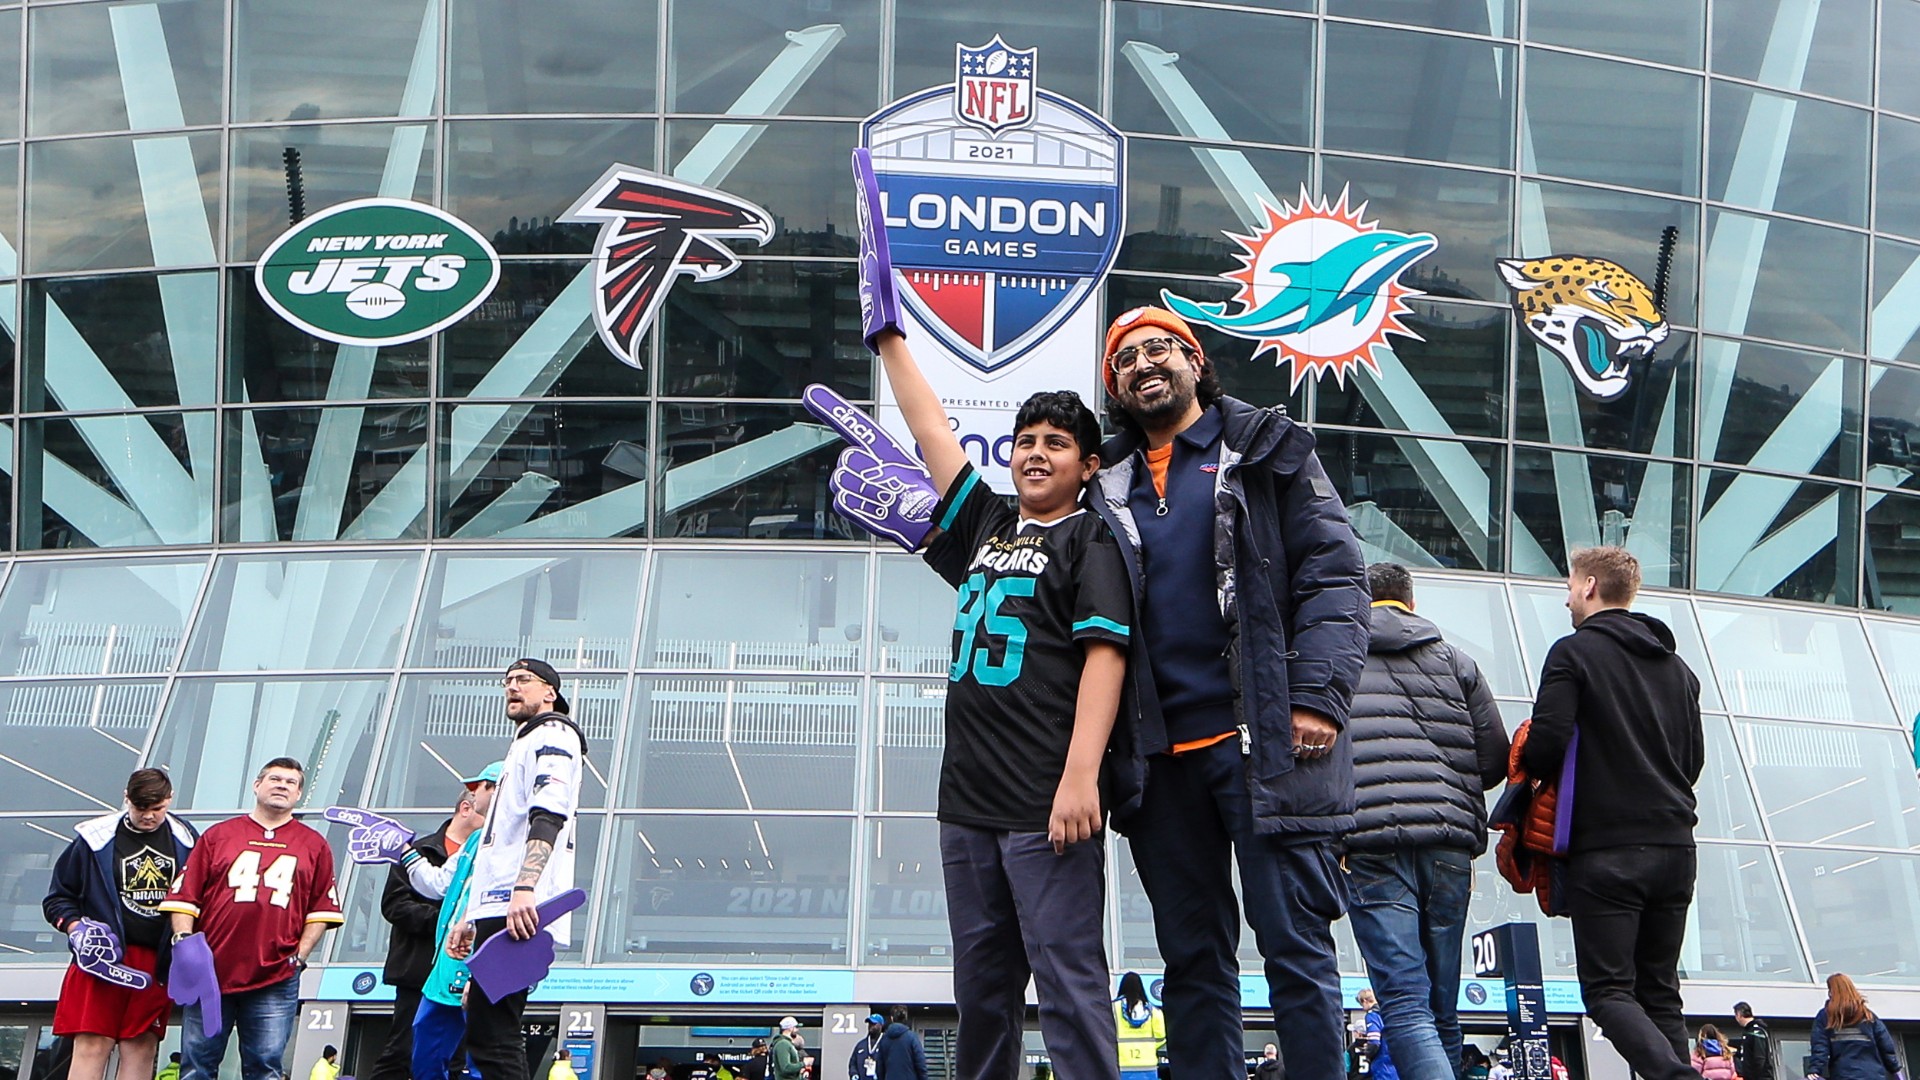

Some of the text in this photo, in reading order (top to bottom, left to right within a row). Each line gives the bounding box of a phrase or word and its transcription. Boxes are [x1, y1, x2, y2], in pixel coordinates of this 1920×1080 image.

[965, 80, 1026, 123] NFL
[969, 145, 1014, 160] 2021
[879, 191, 1106, 237] LONDON
[306, 233, 449, 252] NEW YORK
[944, 239, 1038, 259] GAMES
[287, 254, 467, 296] JETS
[942, 398, 1009, 408] PRESENTED
[832, 406, 876, 444] cinch
[338, 810, 363, 824] cinch
[227, 850, 298, 910] 44
[726, 886, 813, 913] 2021
[819, 888, 882, 915] NL
[1473, 933, 1496, 974] 20
[109, 966, 133, 983] cinch
[308, 1009, 334, 1030] 21
[567, 1011, 594, 1031] 21
[831, 1013, 858, 1034] 21
[1130, 1049, 1141, 1059] 12
[1359, 1055, 1370, 1073] 5
